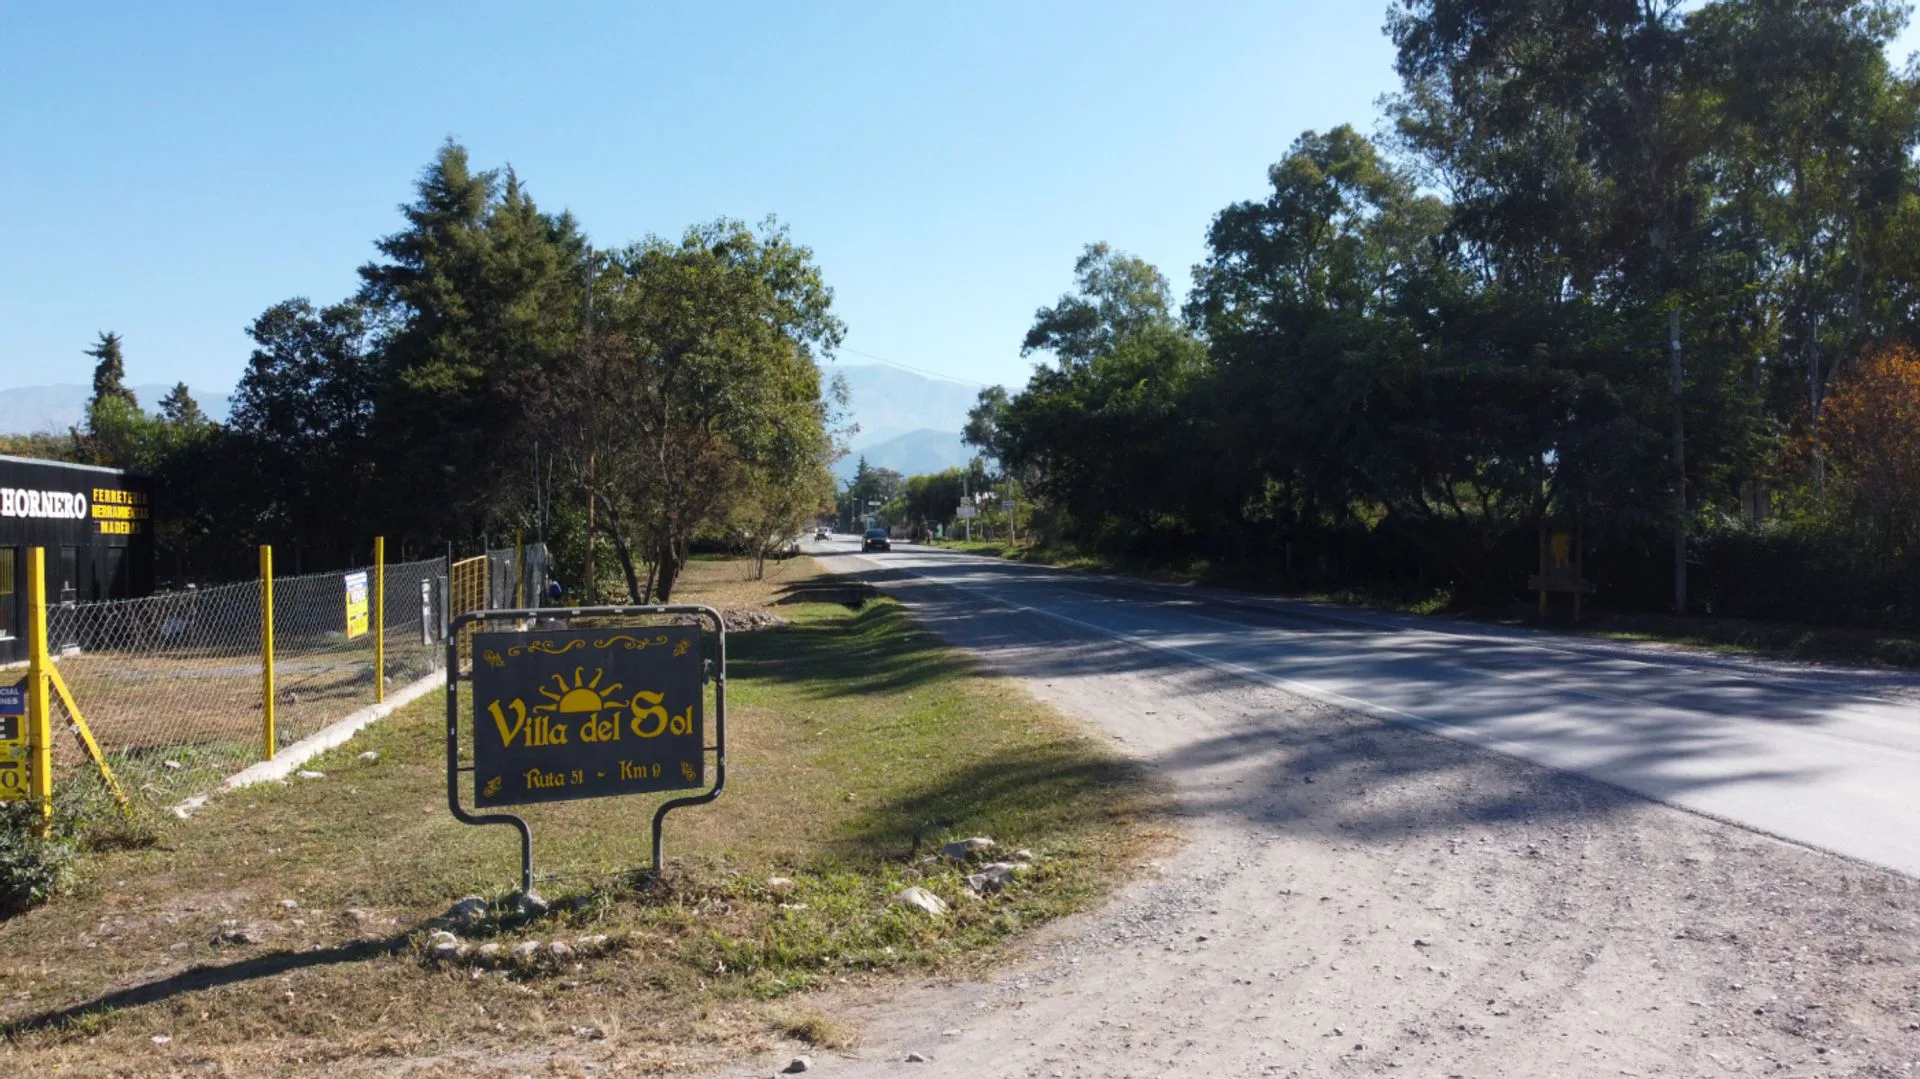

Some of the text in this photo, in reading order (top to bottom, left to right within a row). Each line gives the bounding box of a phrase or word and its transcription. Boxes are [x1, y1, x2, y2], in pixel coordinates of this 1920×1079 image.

[0, 487, 87, 519] HORNERO
[488, 691, 694, 747] Villa del Sol
[525, 768, 566, 789] Ruta
[570, 769, 584, 785] 51
[618, 760, 648, 781] Km
[652, 762, 663, 777] 9
